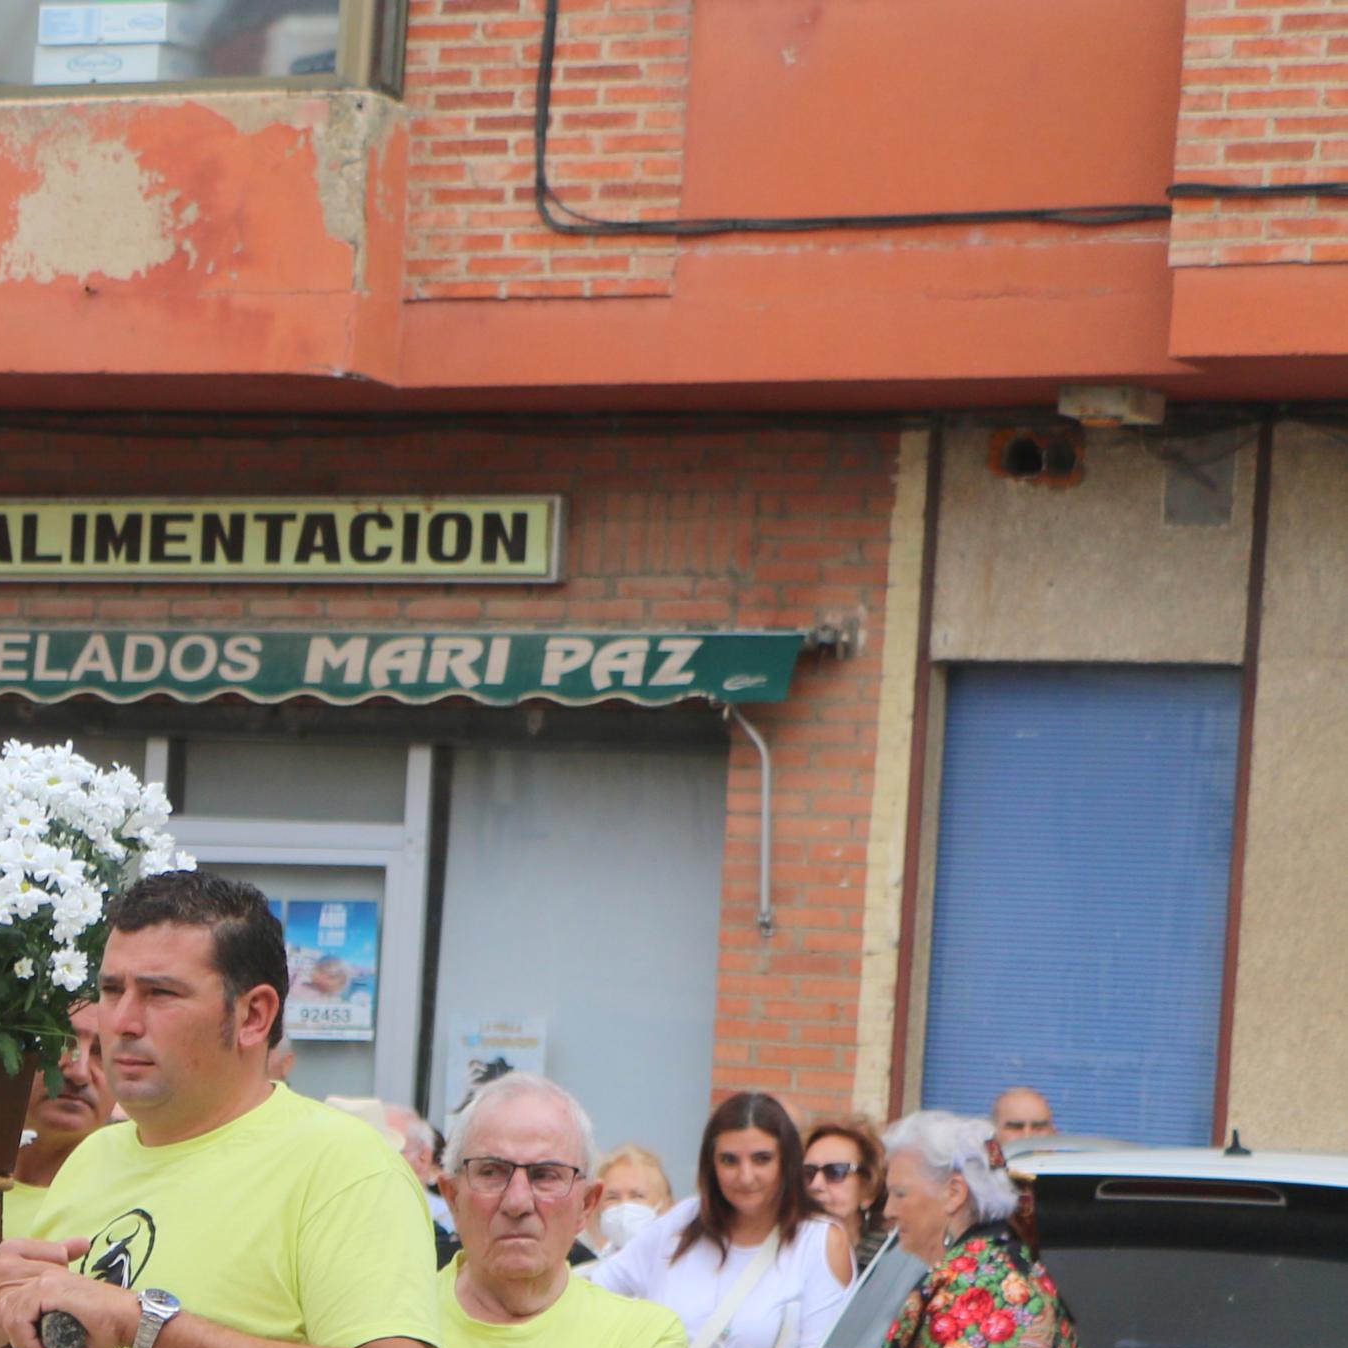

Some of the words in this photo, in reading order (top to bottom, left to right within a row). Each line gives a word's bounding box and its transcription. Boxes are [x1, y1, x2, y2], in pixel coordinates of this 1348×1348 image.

[303, 636, 512, 690] MARI
[540, 637, 704, 691] PAZ
[299, 1008, 352, 1024] 92453
